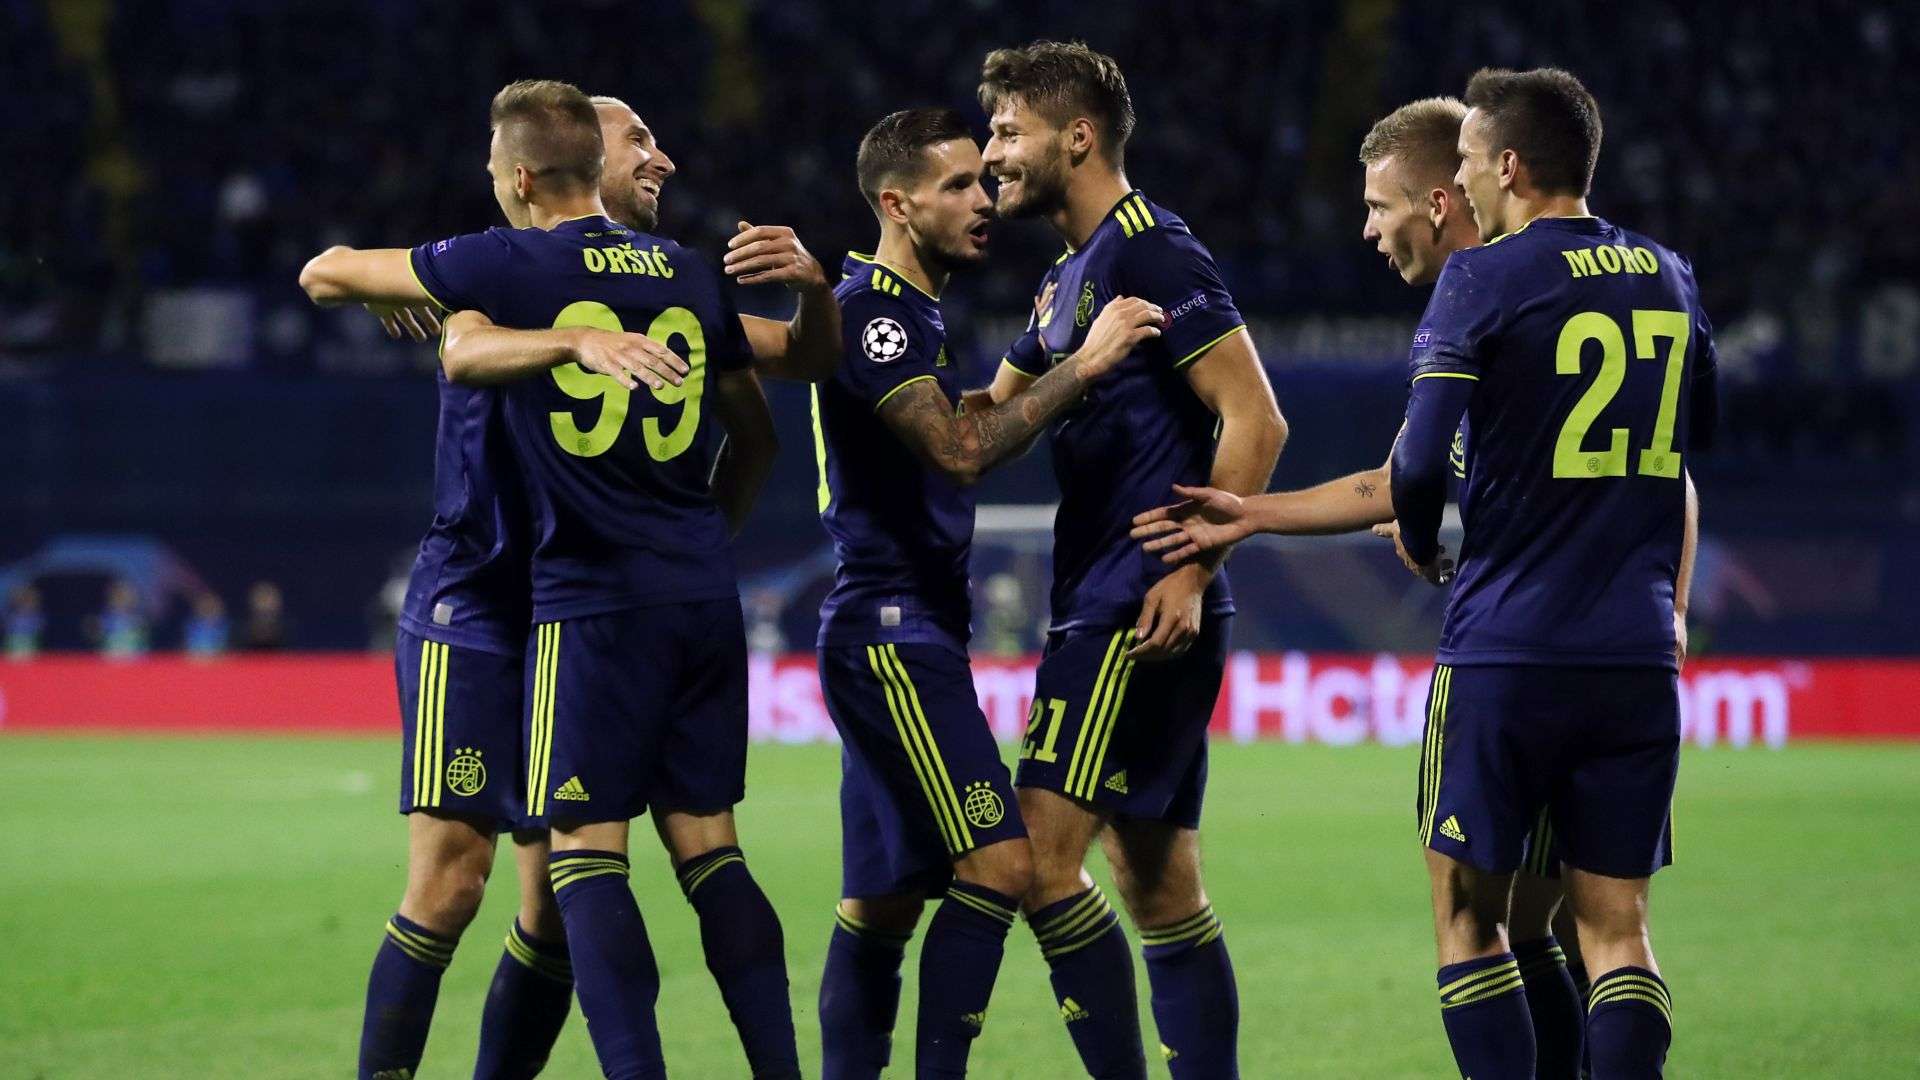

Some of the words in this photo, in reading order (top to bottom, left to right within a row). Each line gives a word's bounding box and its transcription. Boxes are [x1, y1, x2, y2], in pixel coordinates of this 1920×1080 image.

[583, 243, 674, 278] ORŠIĆ
[1561, 245, 1659, 278] MORO
[1170, 293, 1208, 319] RESPECT
[550, 300, 706, 462] 99
[1553, 309, 1690, 479] 27
[1020, 697, 1067, 763] 21
[553, 790, 591, 802] adidas
[1439, 825, 1466, 843] adidas
